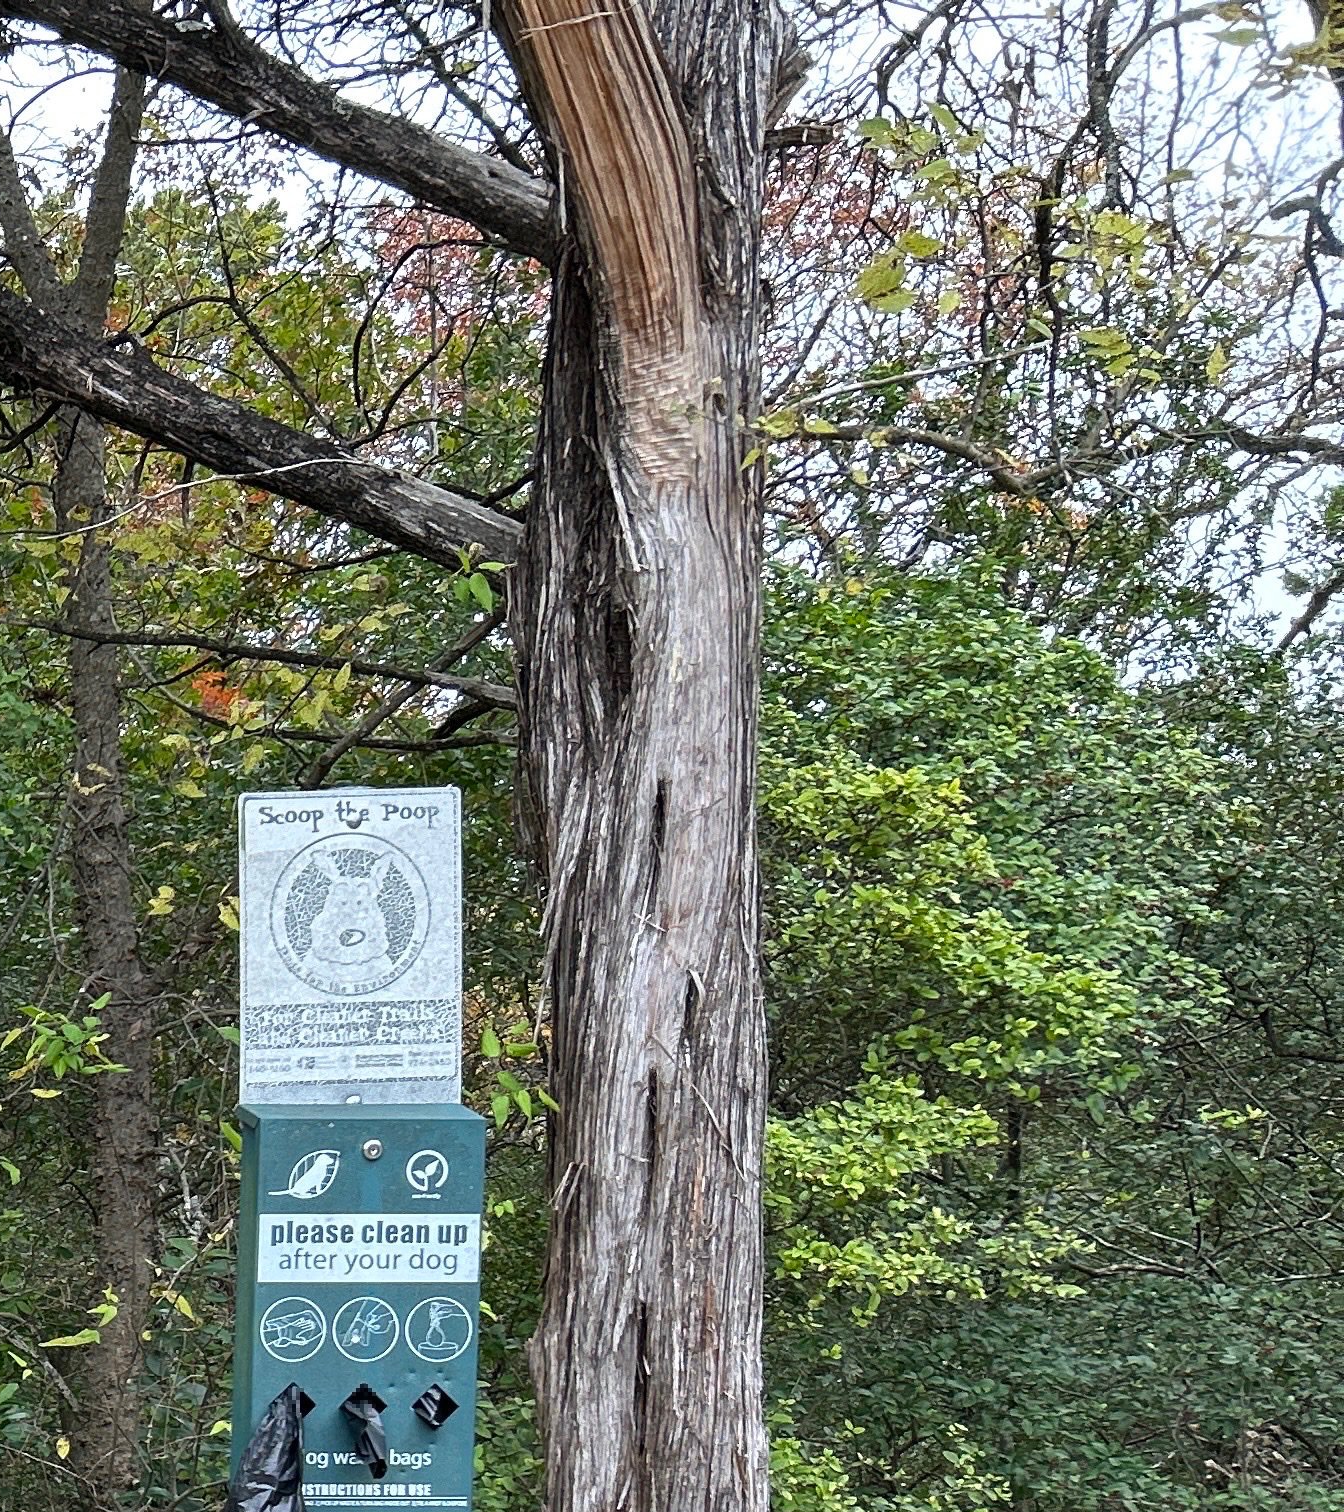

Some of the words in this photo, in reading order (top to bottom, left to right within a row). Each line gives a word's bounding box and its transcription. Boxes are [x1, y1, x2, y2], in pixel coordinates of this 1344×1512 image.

[259, 807, 324, 833] Scoop
[380, 804, 439, 829] Poop
[271, 1221, 353, 1246] please
[362, 1221, 429, 1243] clean
[438, 1225, 467, 1246] up
[279, 1248, 337, 1269] after
[344, 1254, 402, 1275] your
[409, 1248, 457, 1275] dog
[306, 1453, 328, 1468] og
[390, 1449, 431, 1469] bags
[302, 1484, 381, 1496] NSTRUCTIONS
[384, 1484, 405, 1495] FOR
[408, 1484, 431, 1496] USE
